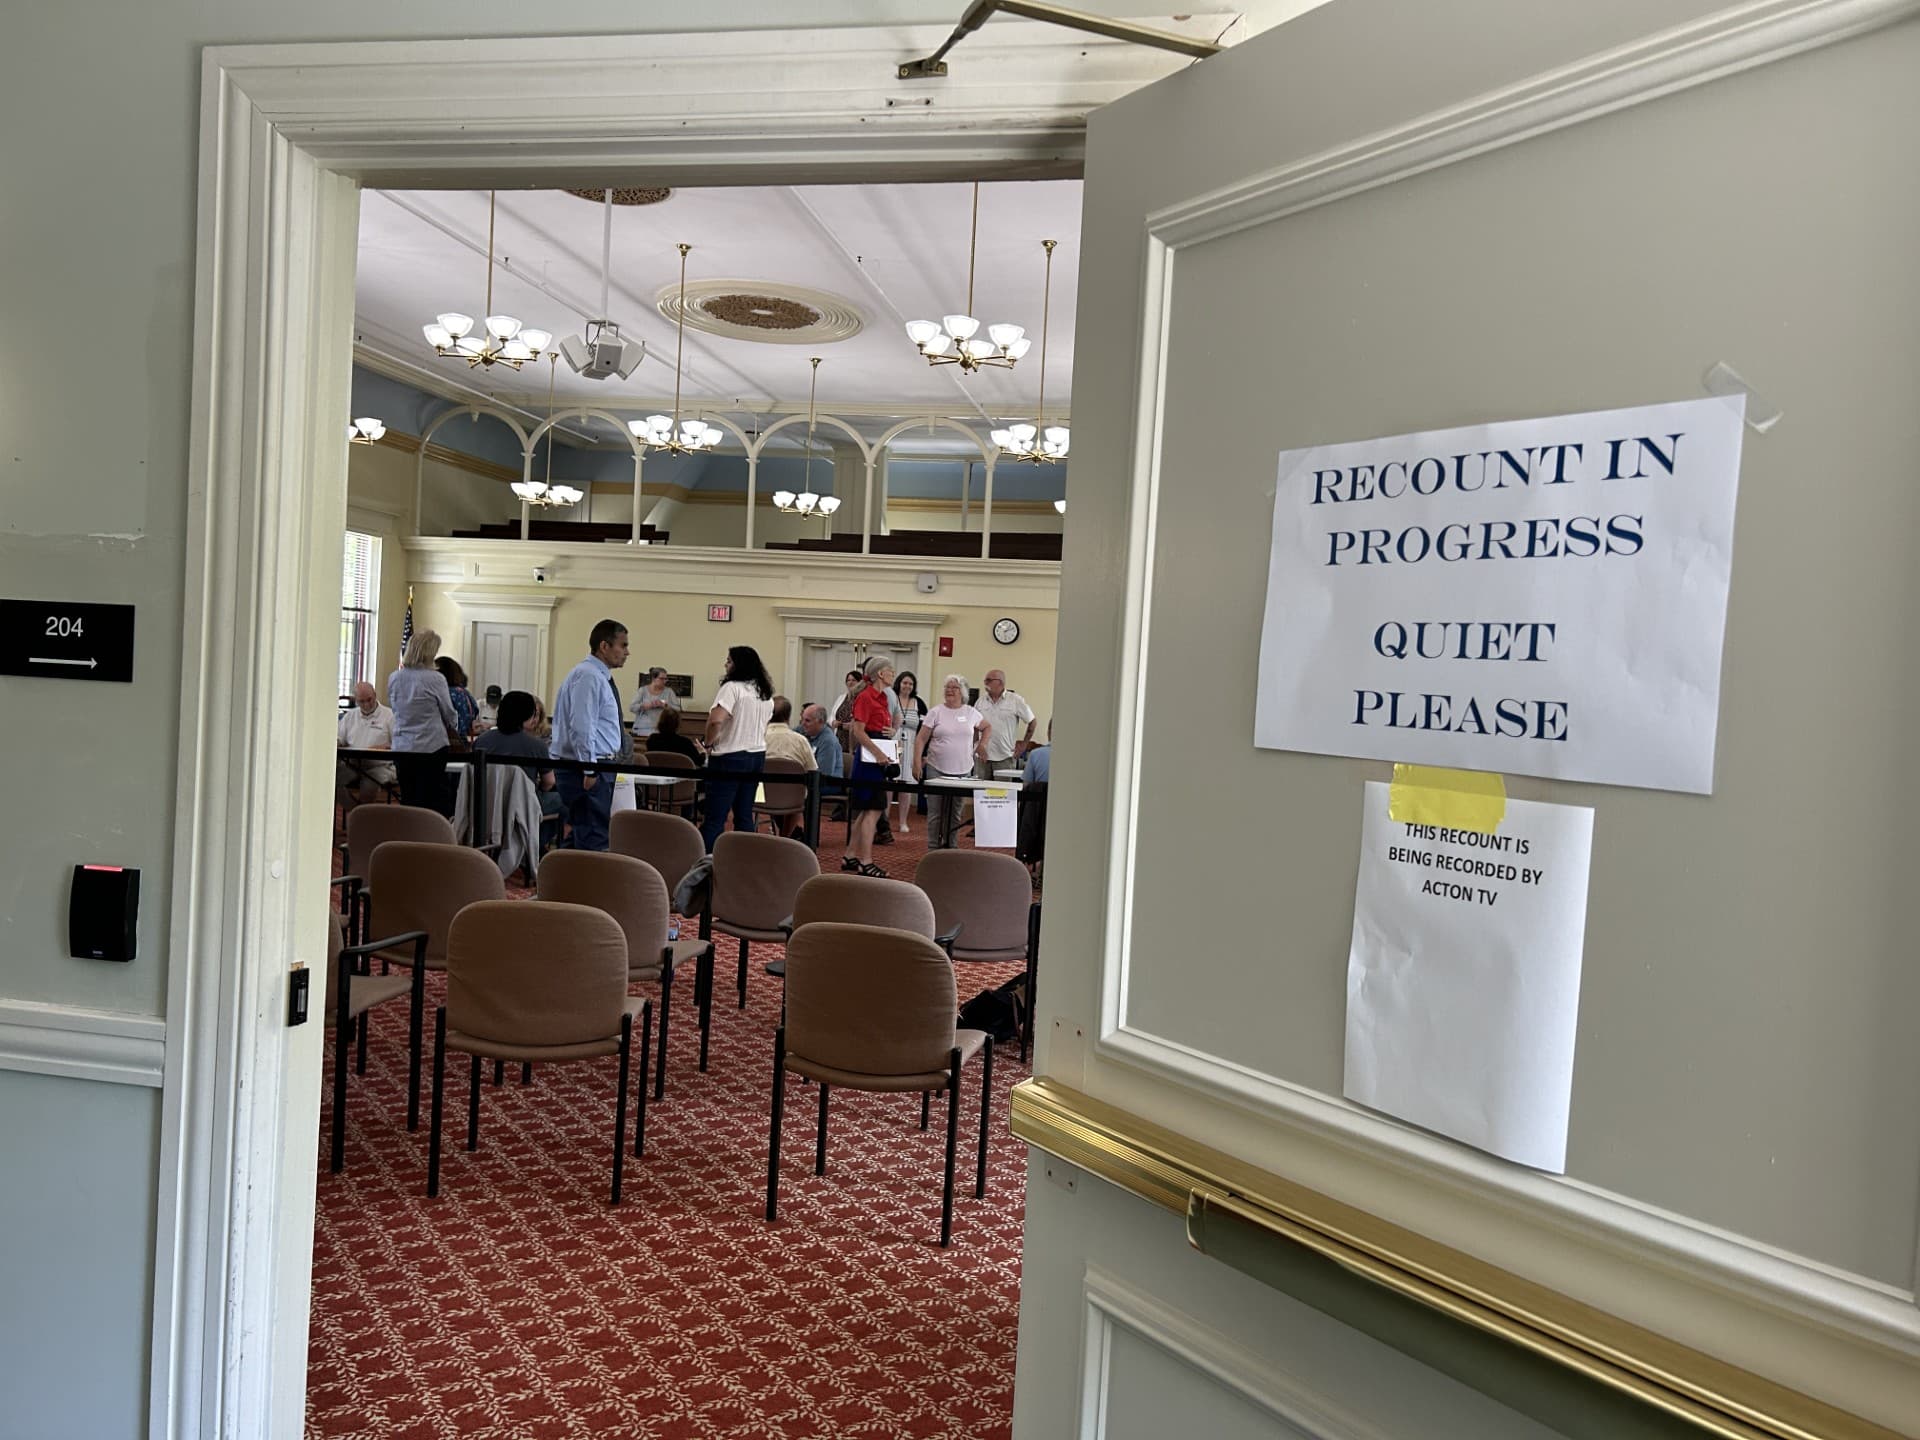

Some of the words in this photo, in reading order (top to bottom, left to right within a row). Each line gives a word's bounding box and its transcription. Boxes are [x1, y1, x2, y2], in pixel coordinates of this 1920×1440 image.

[1310, 443, 1584, 505] RECOUNT
[1601, 433, 1686, 481] IN
[1325, 515, 1645, 566] PROGRESS
[45, 616, 84, 638] 204
[1373, 621, 1556, 662] QUIET
[1351, 689, 1569, 742] PLEASE
[1405, 822, 1437, 841] THIS
[1439, 827, 1513, 852] RECOUNT
[1515, 838, 1530, 856] IS
[1388, 846, 1433, 868] BEING
[1435, 854, 1517, 881] RECORDED
[1521, 868, 1543, 887] BY
[1421, 879, 1473, 902] ACTON
[1477, 889, 1498, 906] TV
